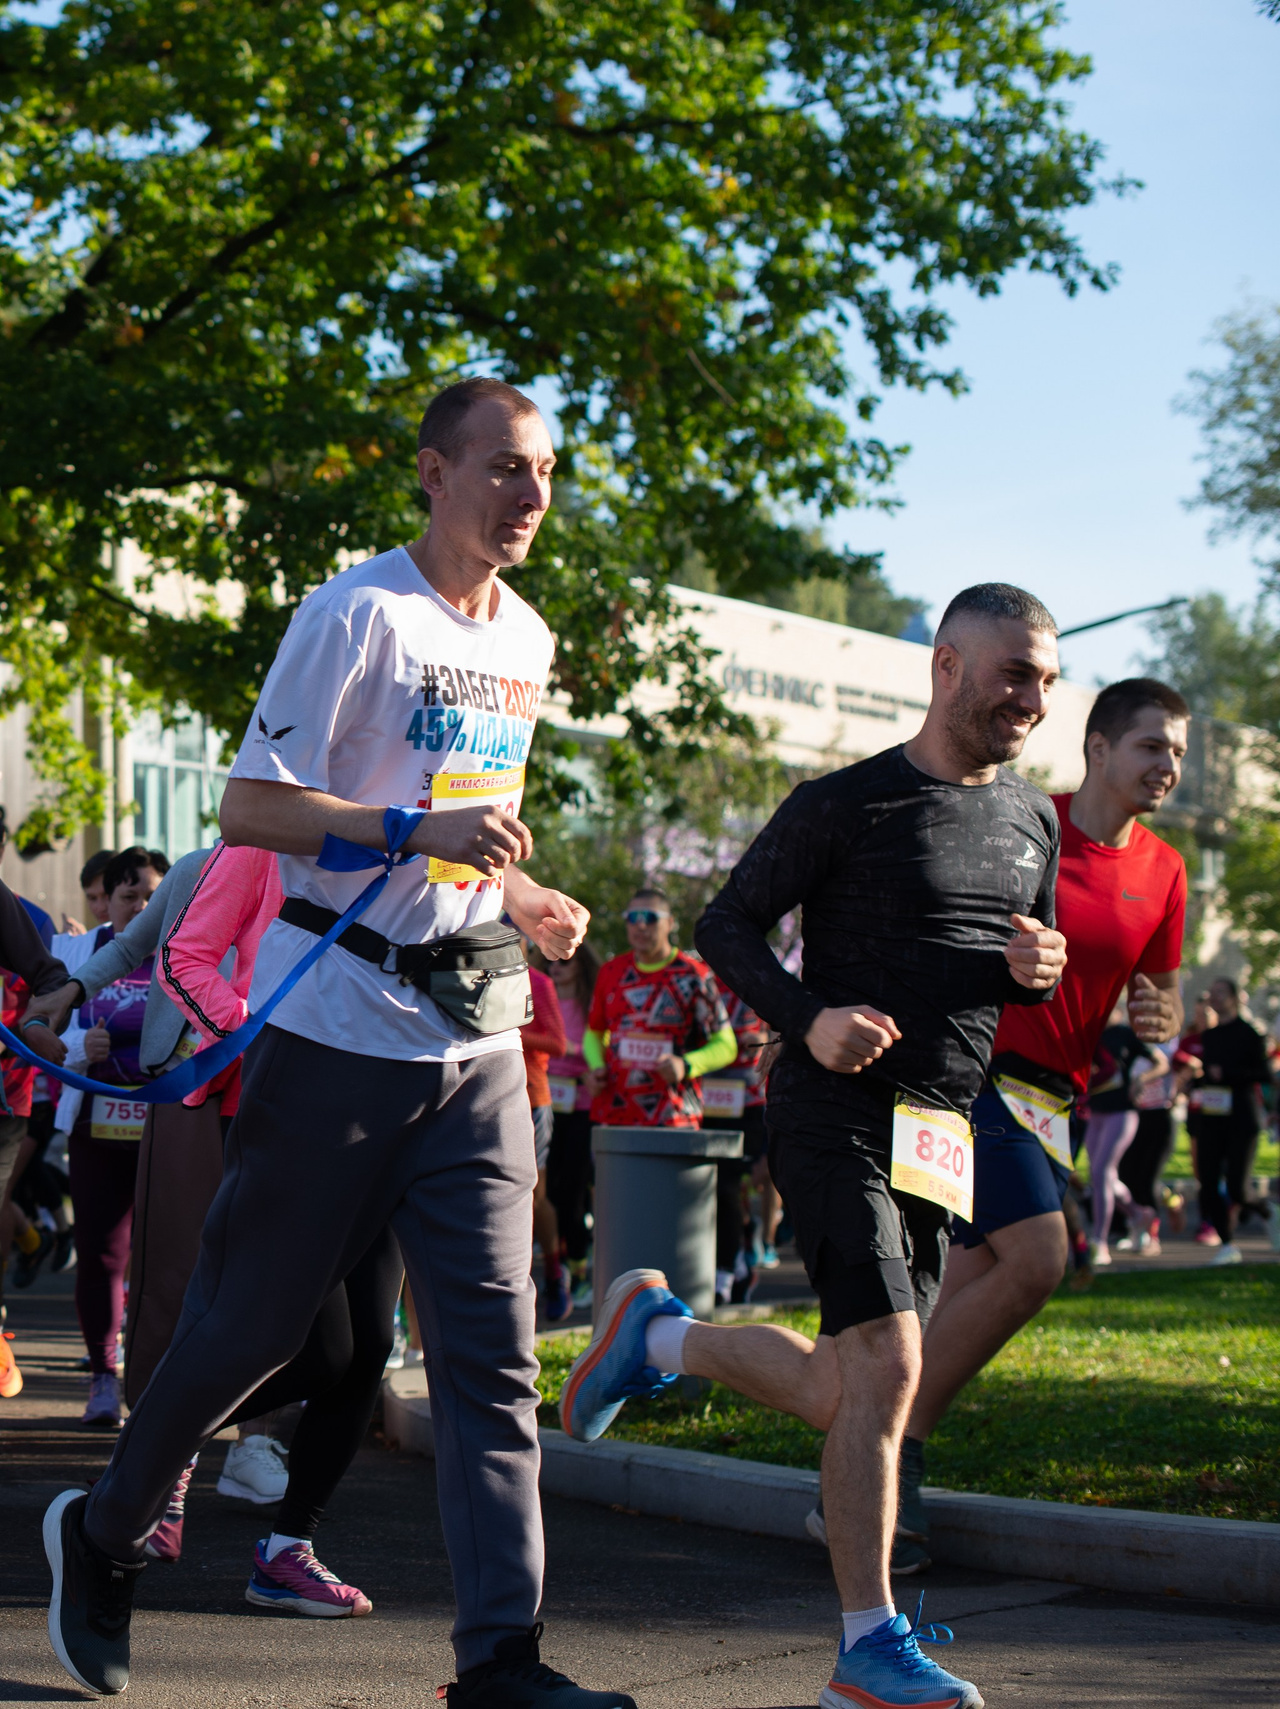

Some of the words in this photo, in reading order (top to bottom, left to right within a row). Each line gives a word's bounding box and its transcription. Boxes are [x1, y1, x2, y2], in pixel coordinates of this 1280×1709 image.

[405, 708, 467, 752] 45%
[105, 1101, 147, 1120] 755
[915, 1129, 964, 1177] 820
